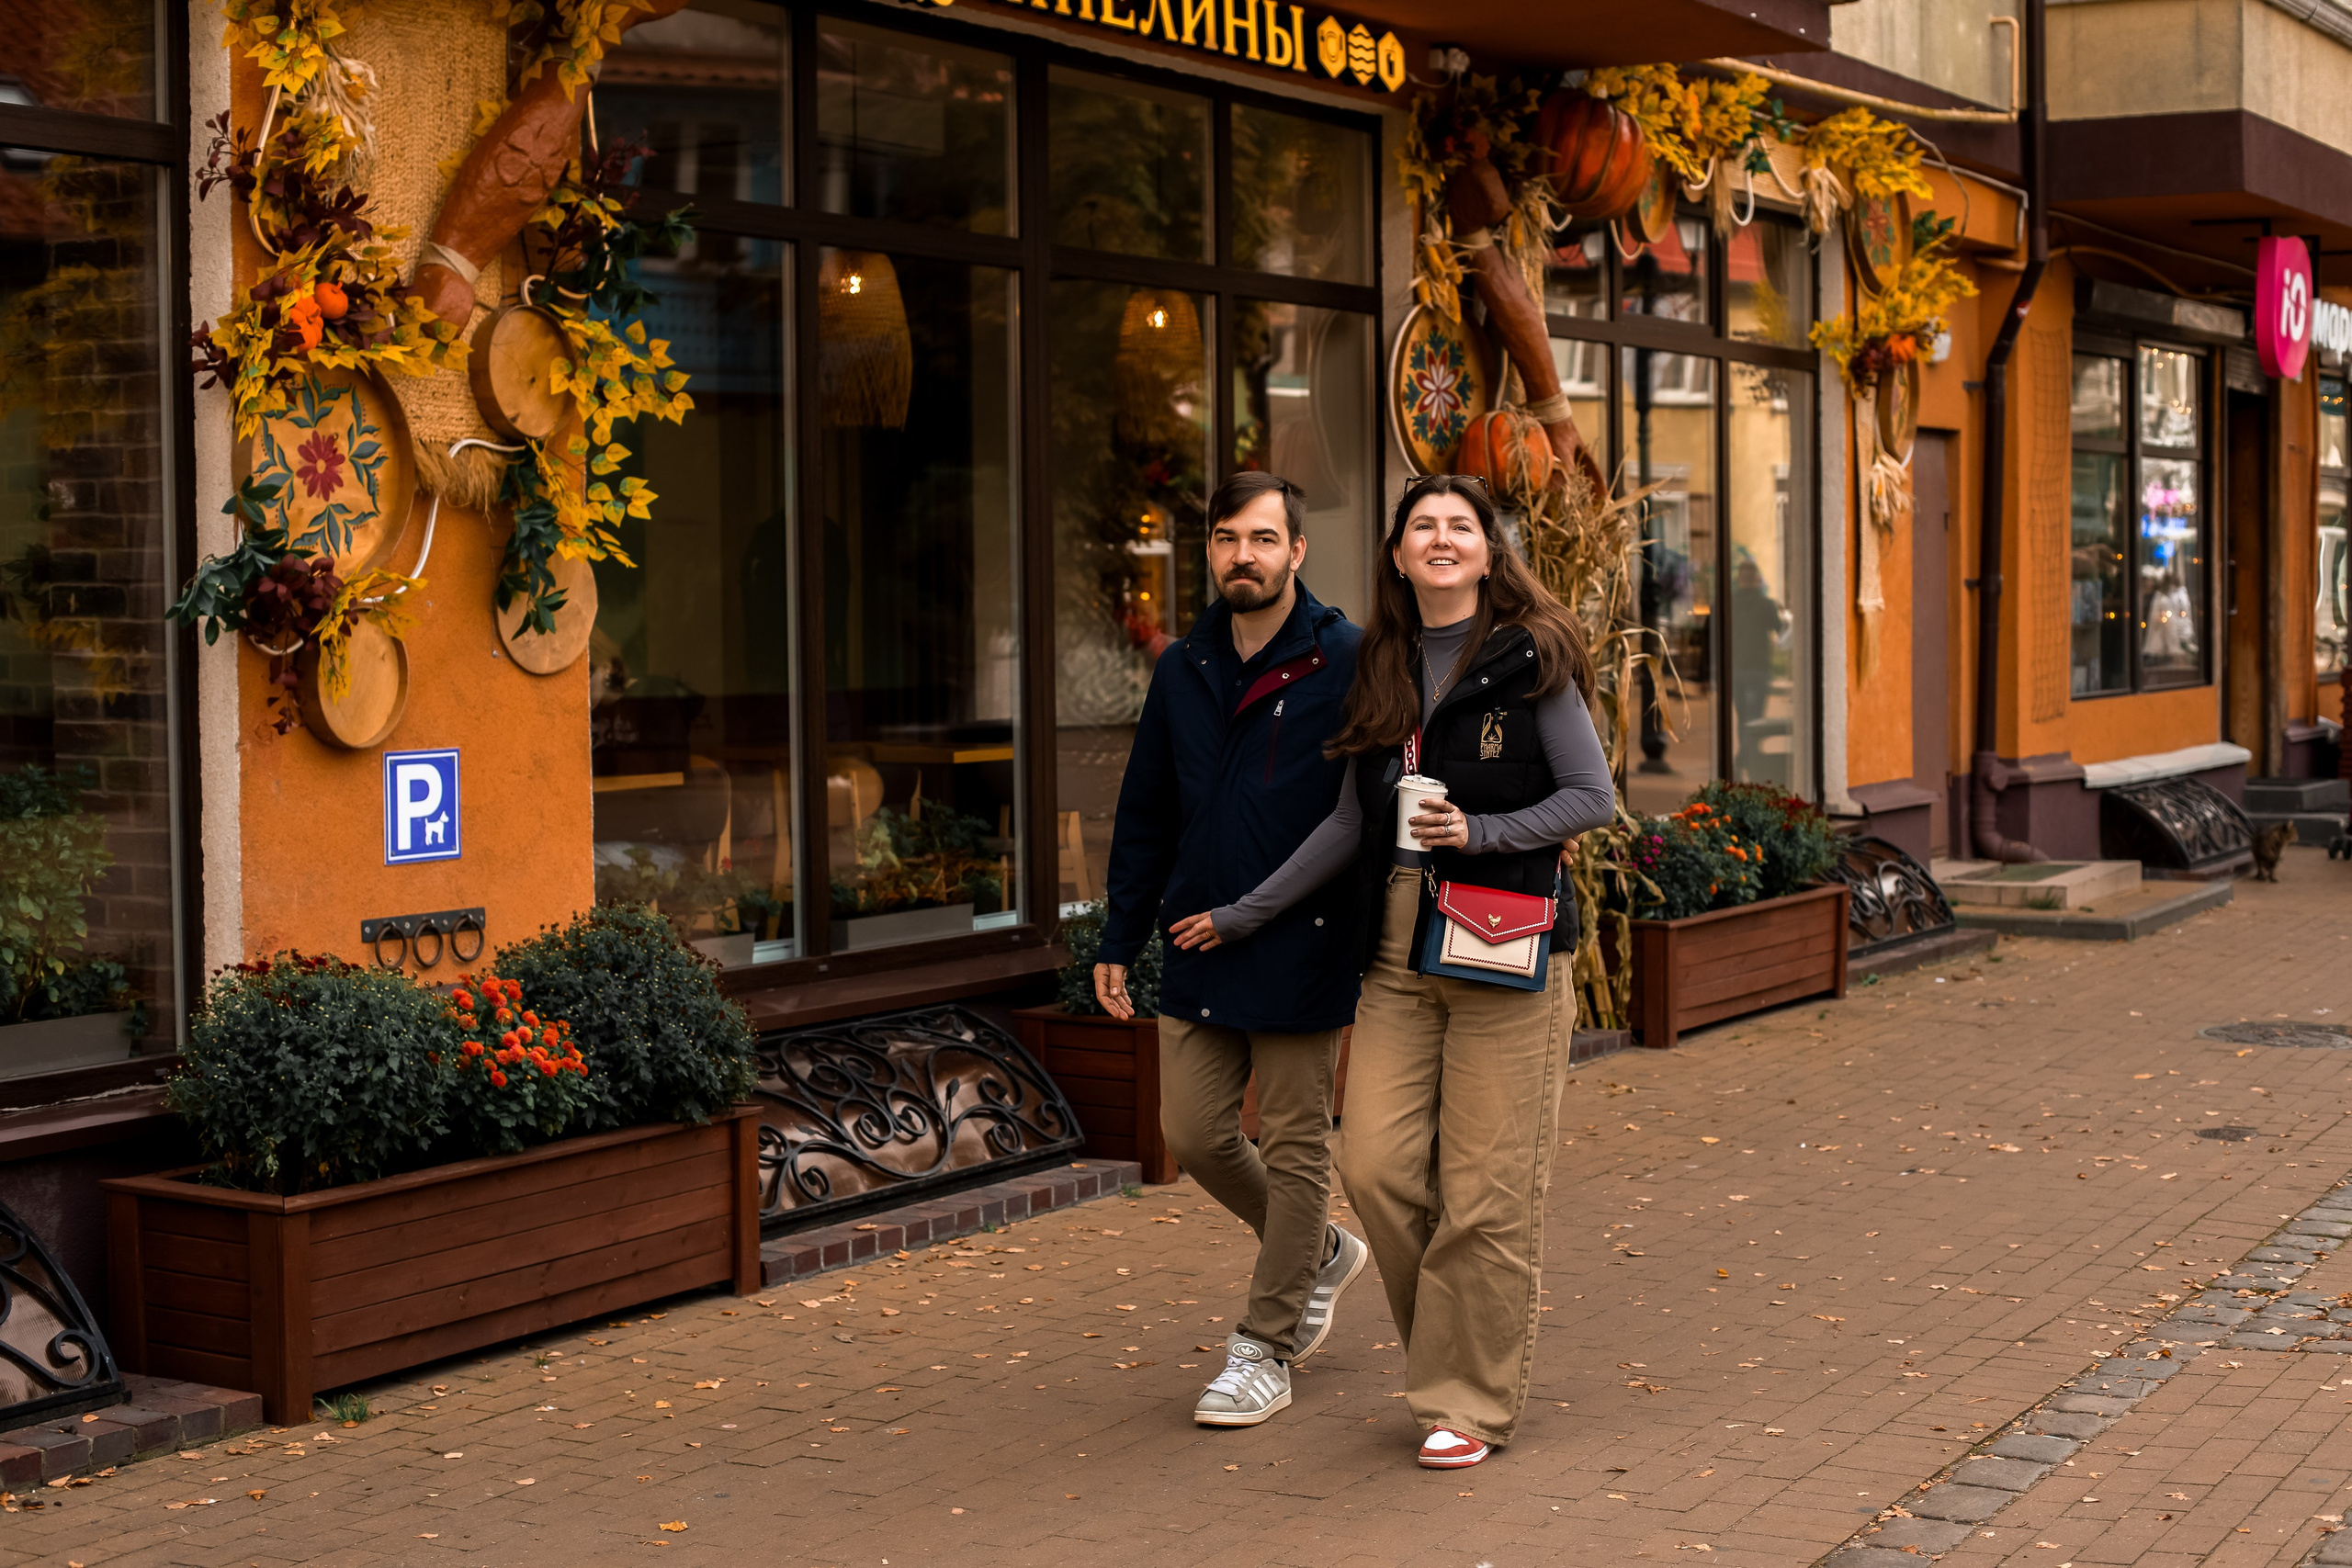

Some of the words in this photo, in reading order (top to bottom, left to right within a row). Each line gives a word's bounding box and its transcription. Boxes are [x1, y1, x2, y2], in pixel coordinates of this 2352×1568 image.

[1007, 0, 1307, 72] ЛИНЫ
[1480, 742, 1503, 751] PHARMA
[396, 763, 443, 851] P
